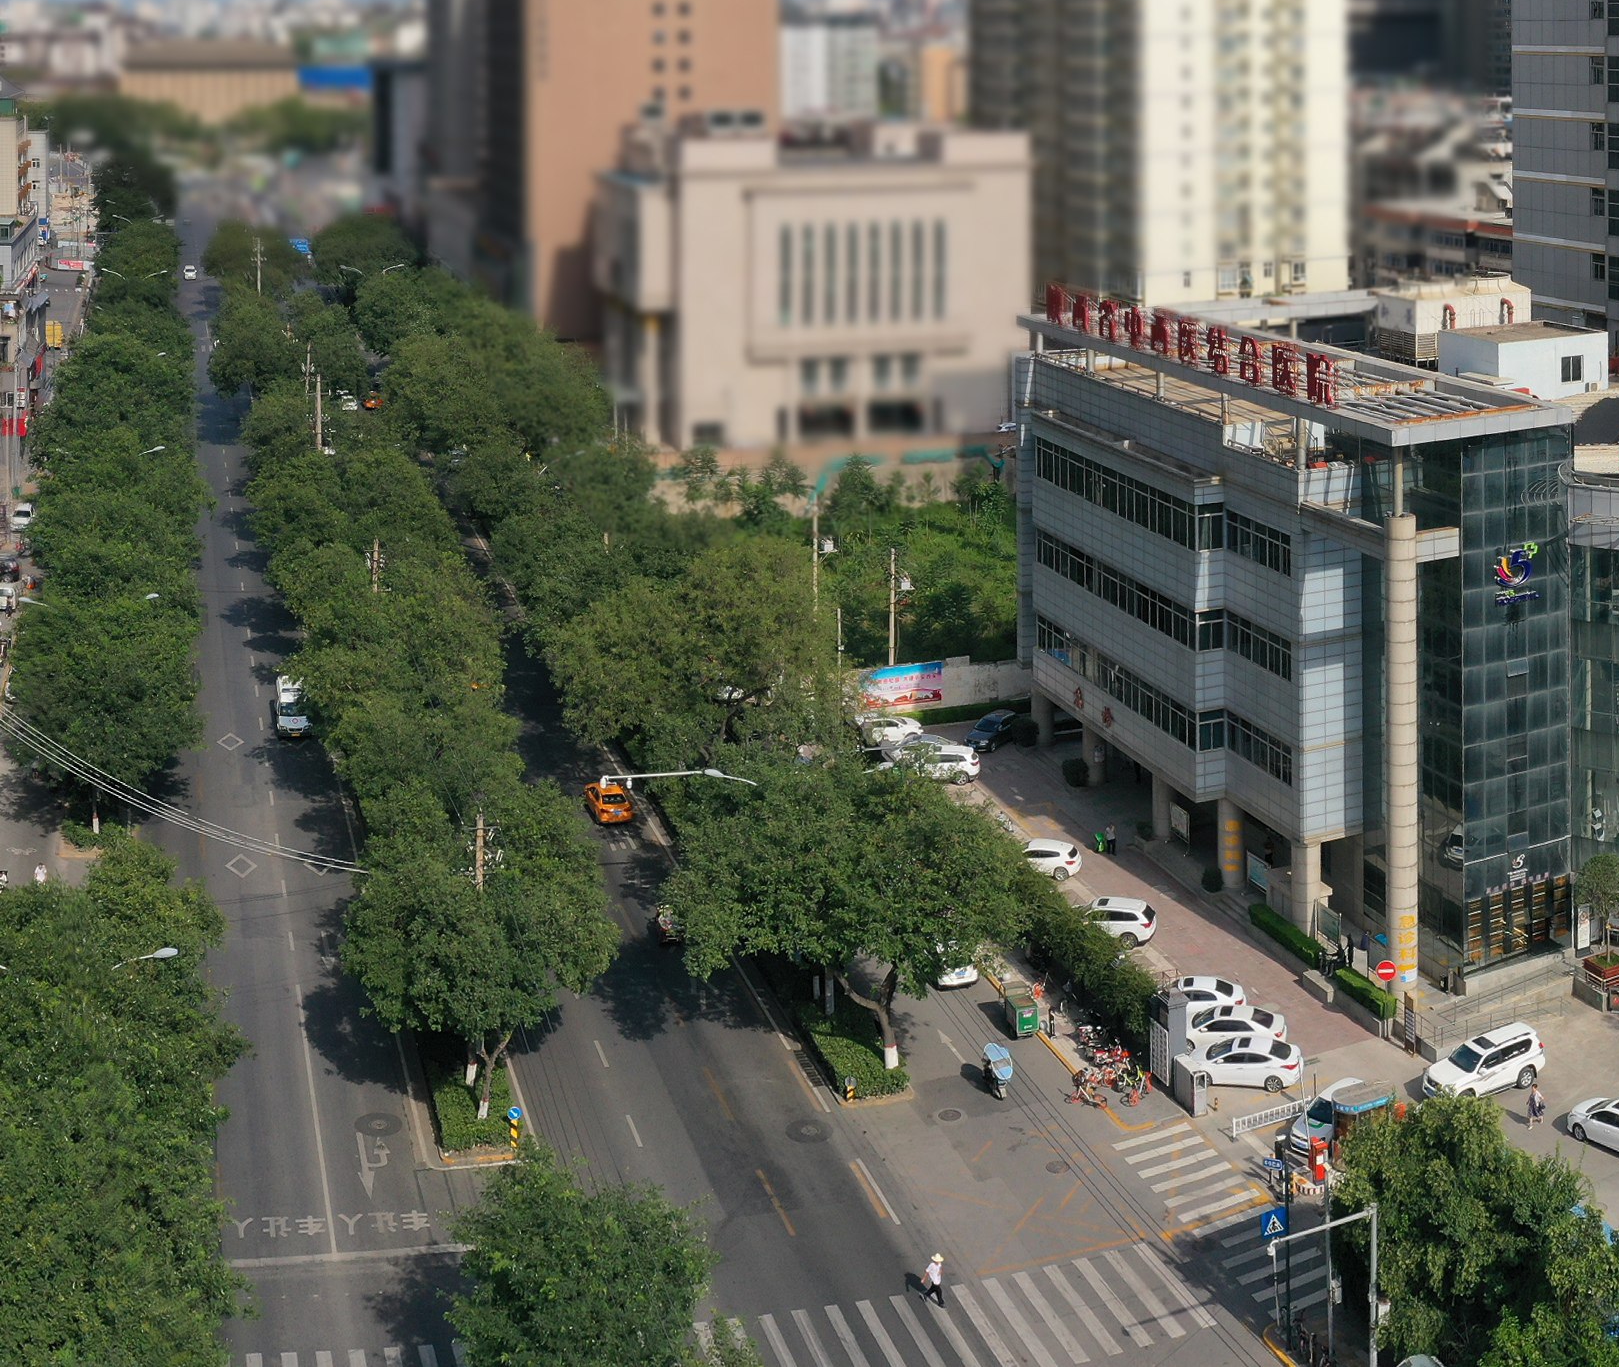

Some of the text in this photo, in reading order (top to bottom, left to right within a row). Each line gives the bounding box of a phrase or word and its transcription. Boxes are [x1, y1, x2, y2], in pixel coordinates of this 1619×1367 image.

[1398, 914, 1417, 960] 急诊科
[233, 1215, 326, 1239] 车让人
[338, 1209, 430, 1235] 车让人
